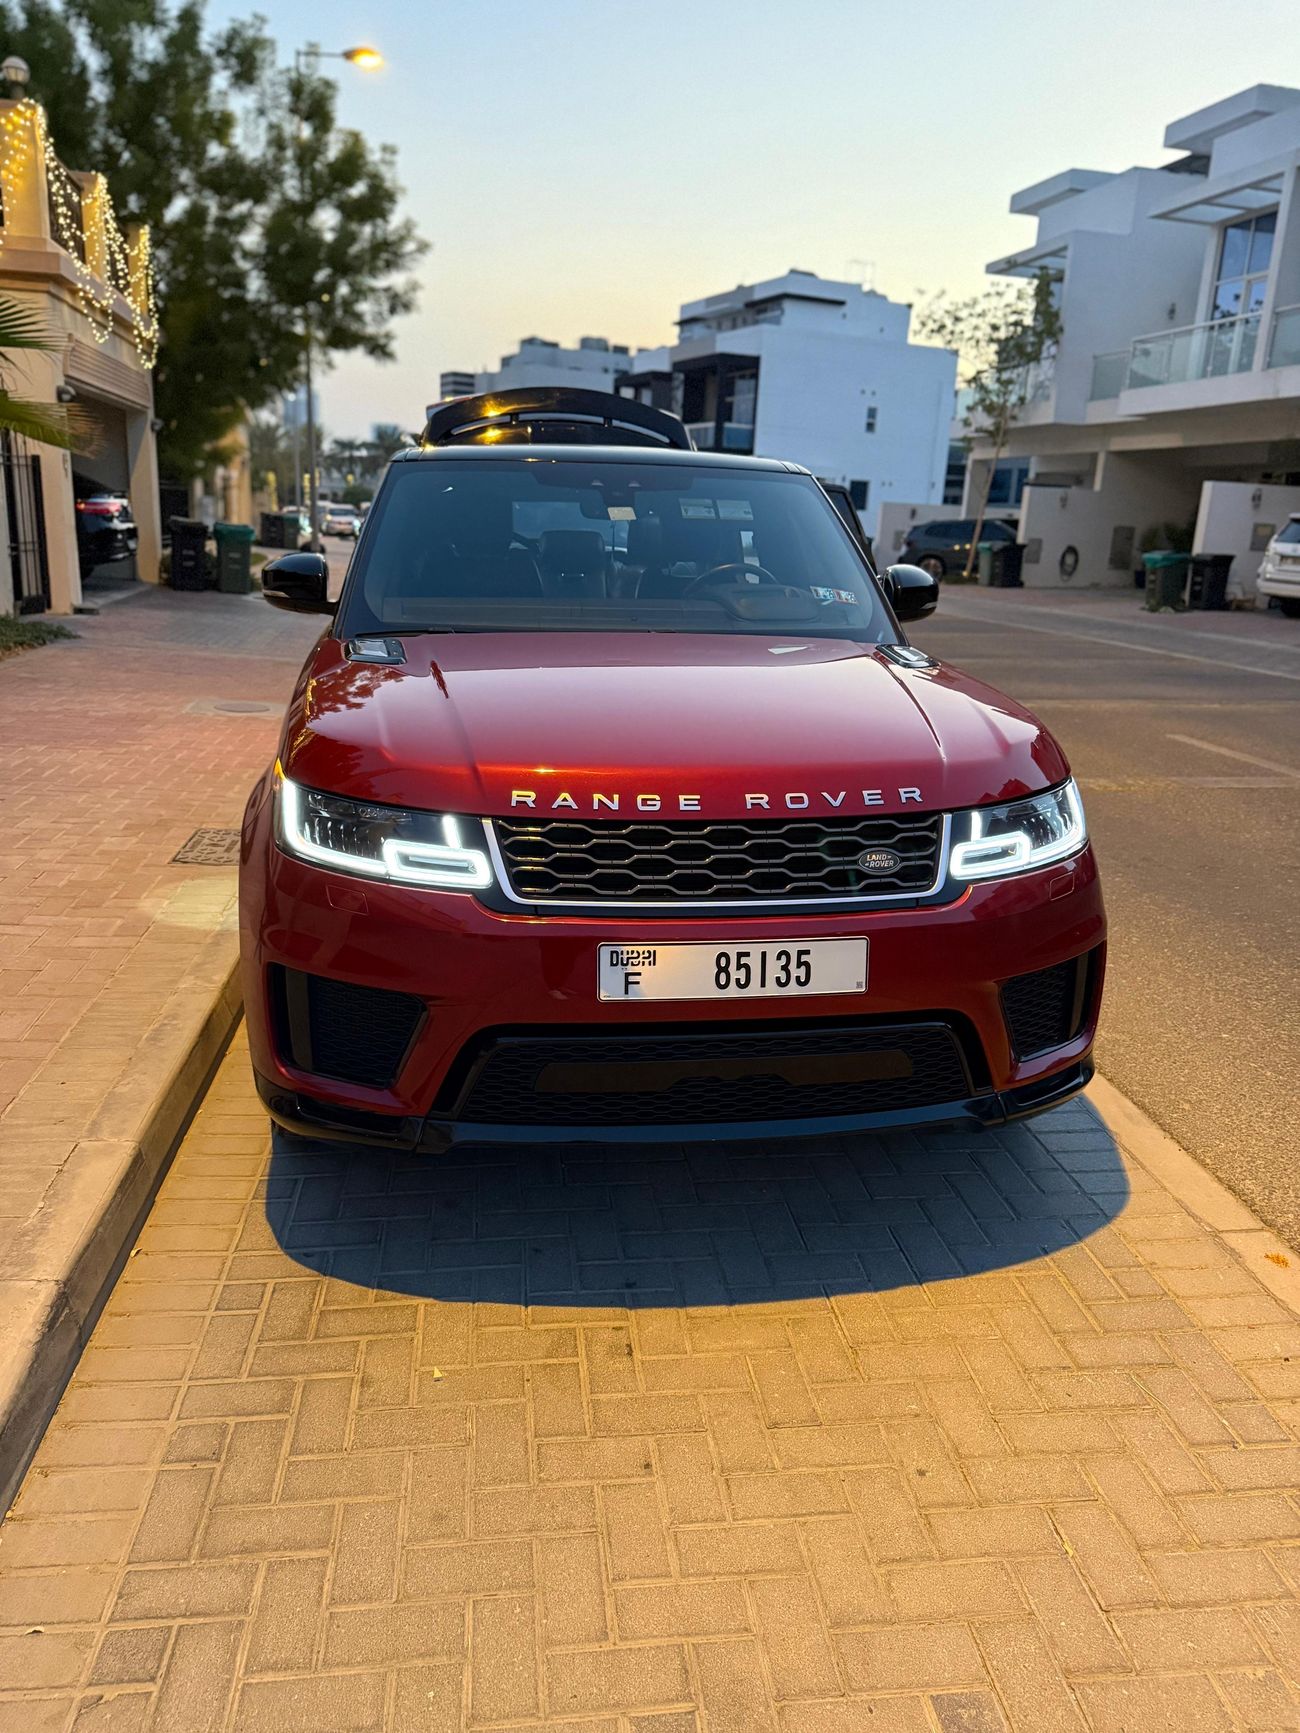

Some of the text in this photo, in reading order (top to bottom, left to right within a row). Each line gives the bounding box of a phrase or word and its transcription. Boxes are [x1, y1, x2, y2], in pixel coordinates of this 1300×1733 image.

[510, 786, 924, 811] RANGE ROVER
[866, 853, 887, 861] LAND
[869, 860, 895, 868] ROVER
[714, 949, 812, 991] 85135
[624, 971, 642, 995] F
